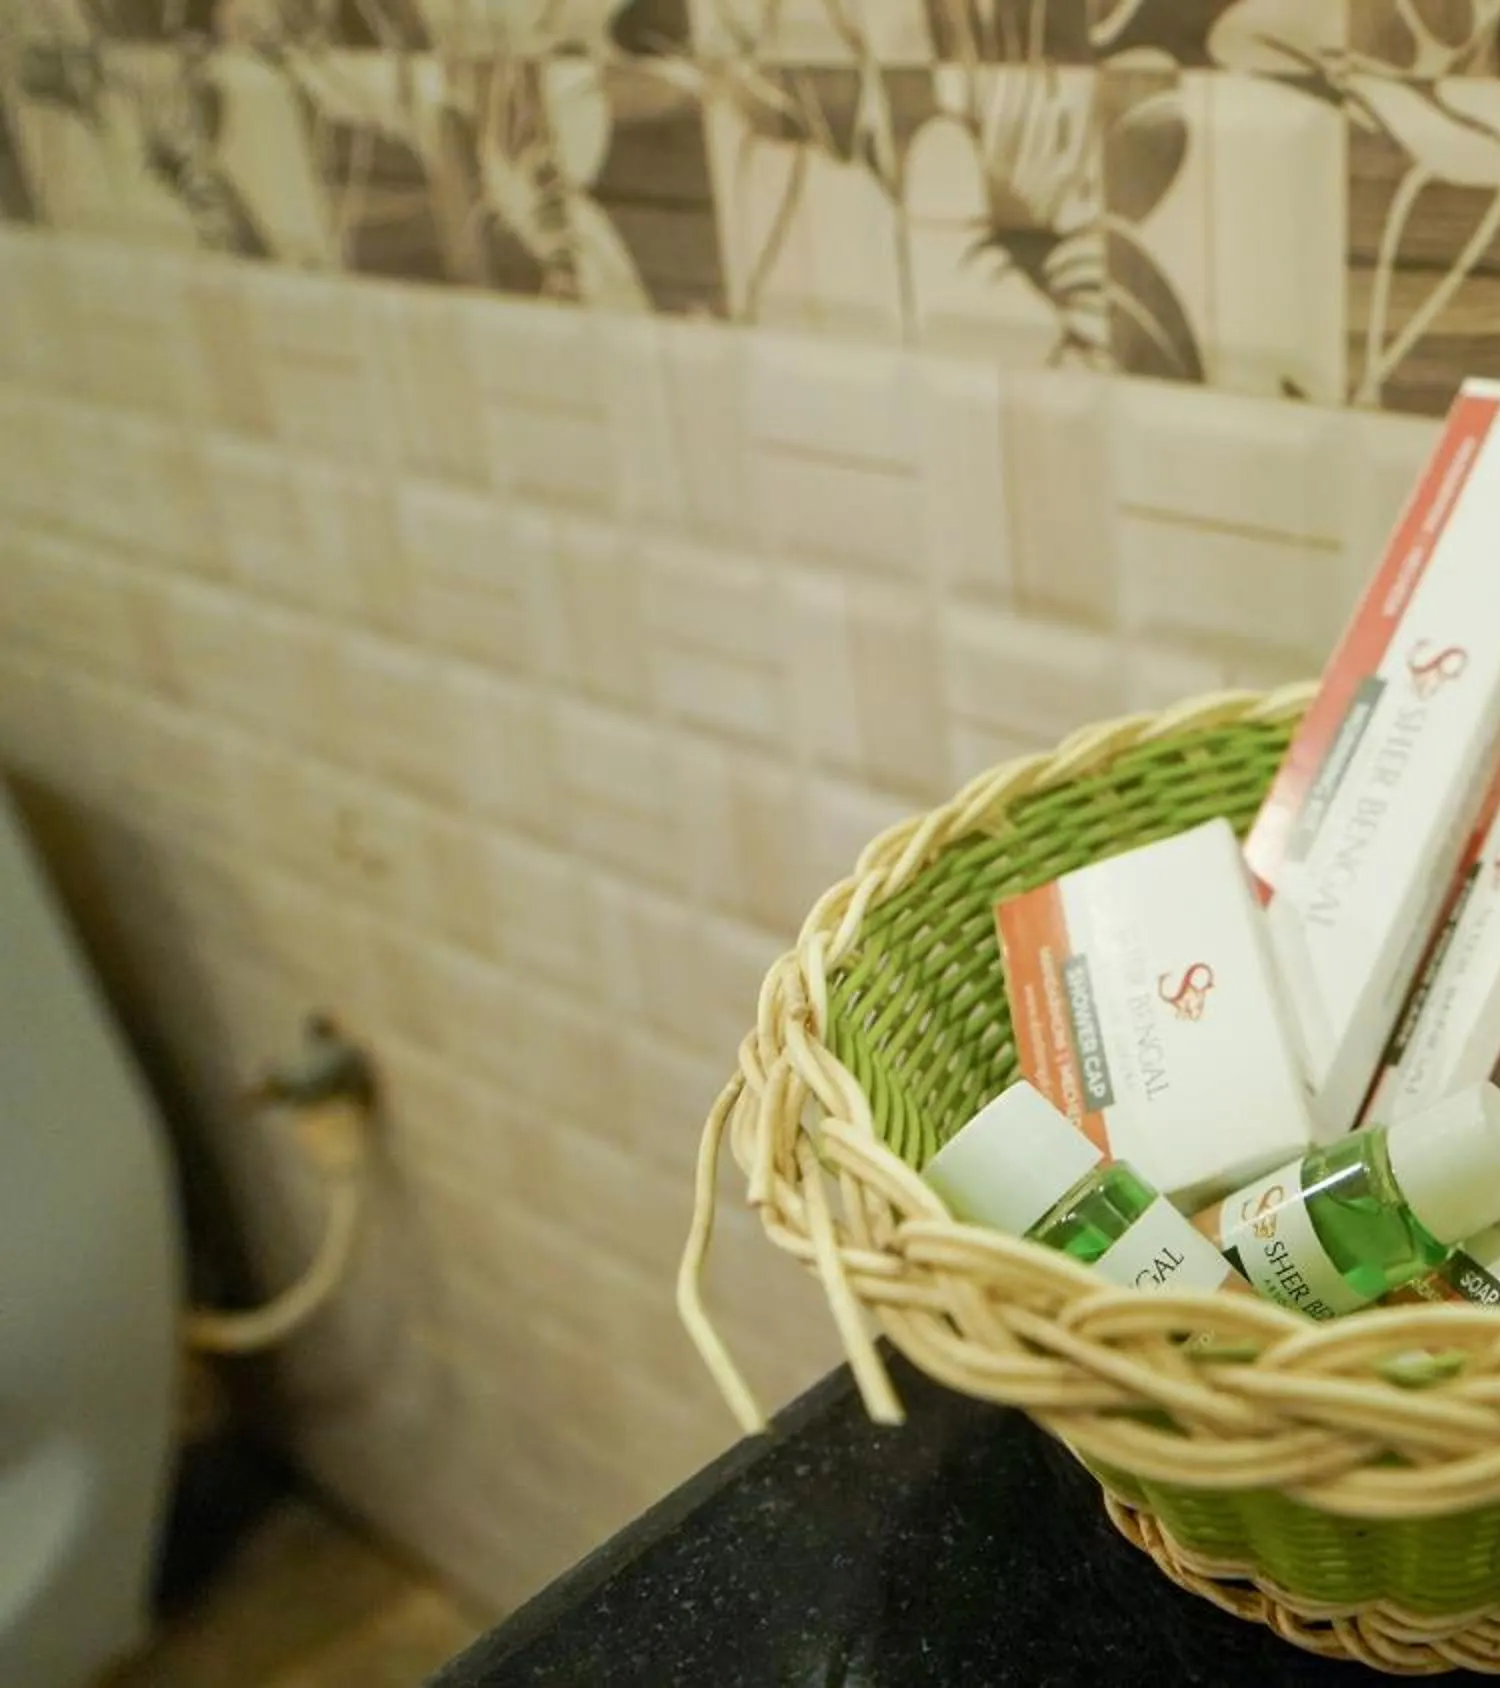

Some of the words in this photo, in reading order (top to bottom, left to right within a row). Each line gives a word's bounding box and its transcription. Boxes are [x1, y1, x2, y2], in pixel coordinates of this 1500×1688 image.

[1068, 964, 1099, 1052] SHOWER
[1083, 1055, 1106, 1098] CAP
[1132, 1247, 1185, 1289] GAL
[1264, 1241, 1315, 1301] SHER
[1460, 1271, 1500, 1305] SOAP
